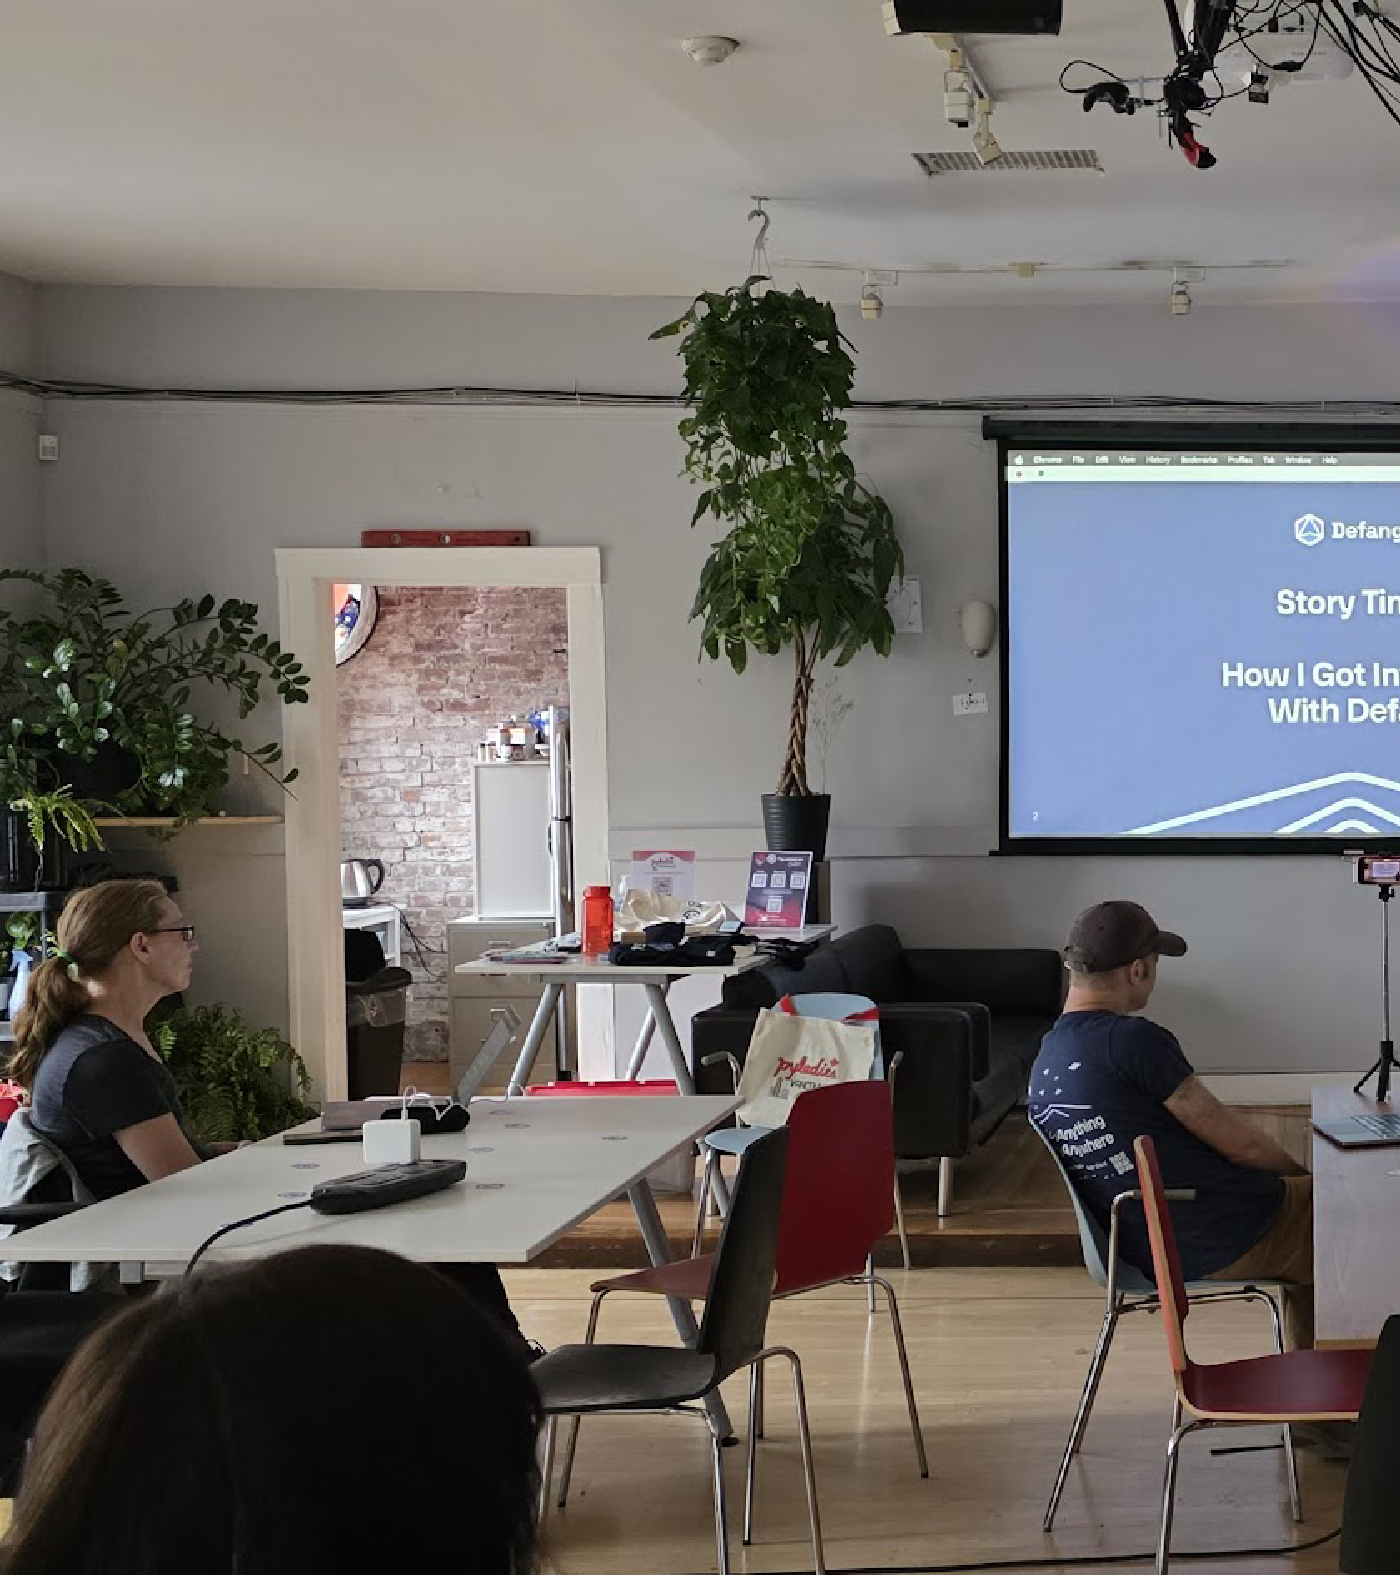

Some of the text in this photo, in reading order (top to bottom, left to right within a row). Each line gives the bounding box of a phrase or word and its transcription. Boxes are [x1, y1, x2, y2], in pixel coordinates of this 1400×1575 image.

[1276, 588, 1356, 619] Story
[1221, 662, 1290, 687] How
[1297, 662, 1304, 687] I
[1312, 662, 1366, 687] Got
[1268, 697, 1340, 723] With
[1050, 1114, 1107, 1142] Anything
[1062, 1133, 1115, 1158] Anywhere
